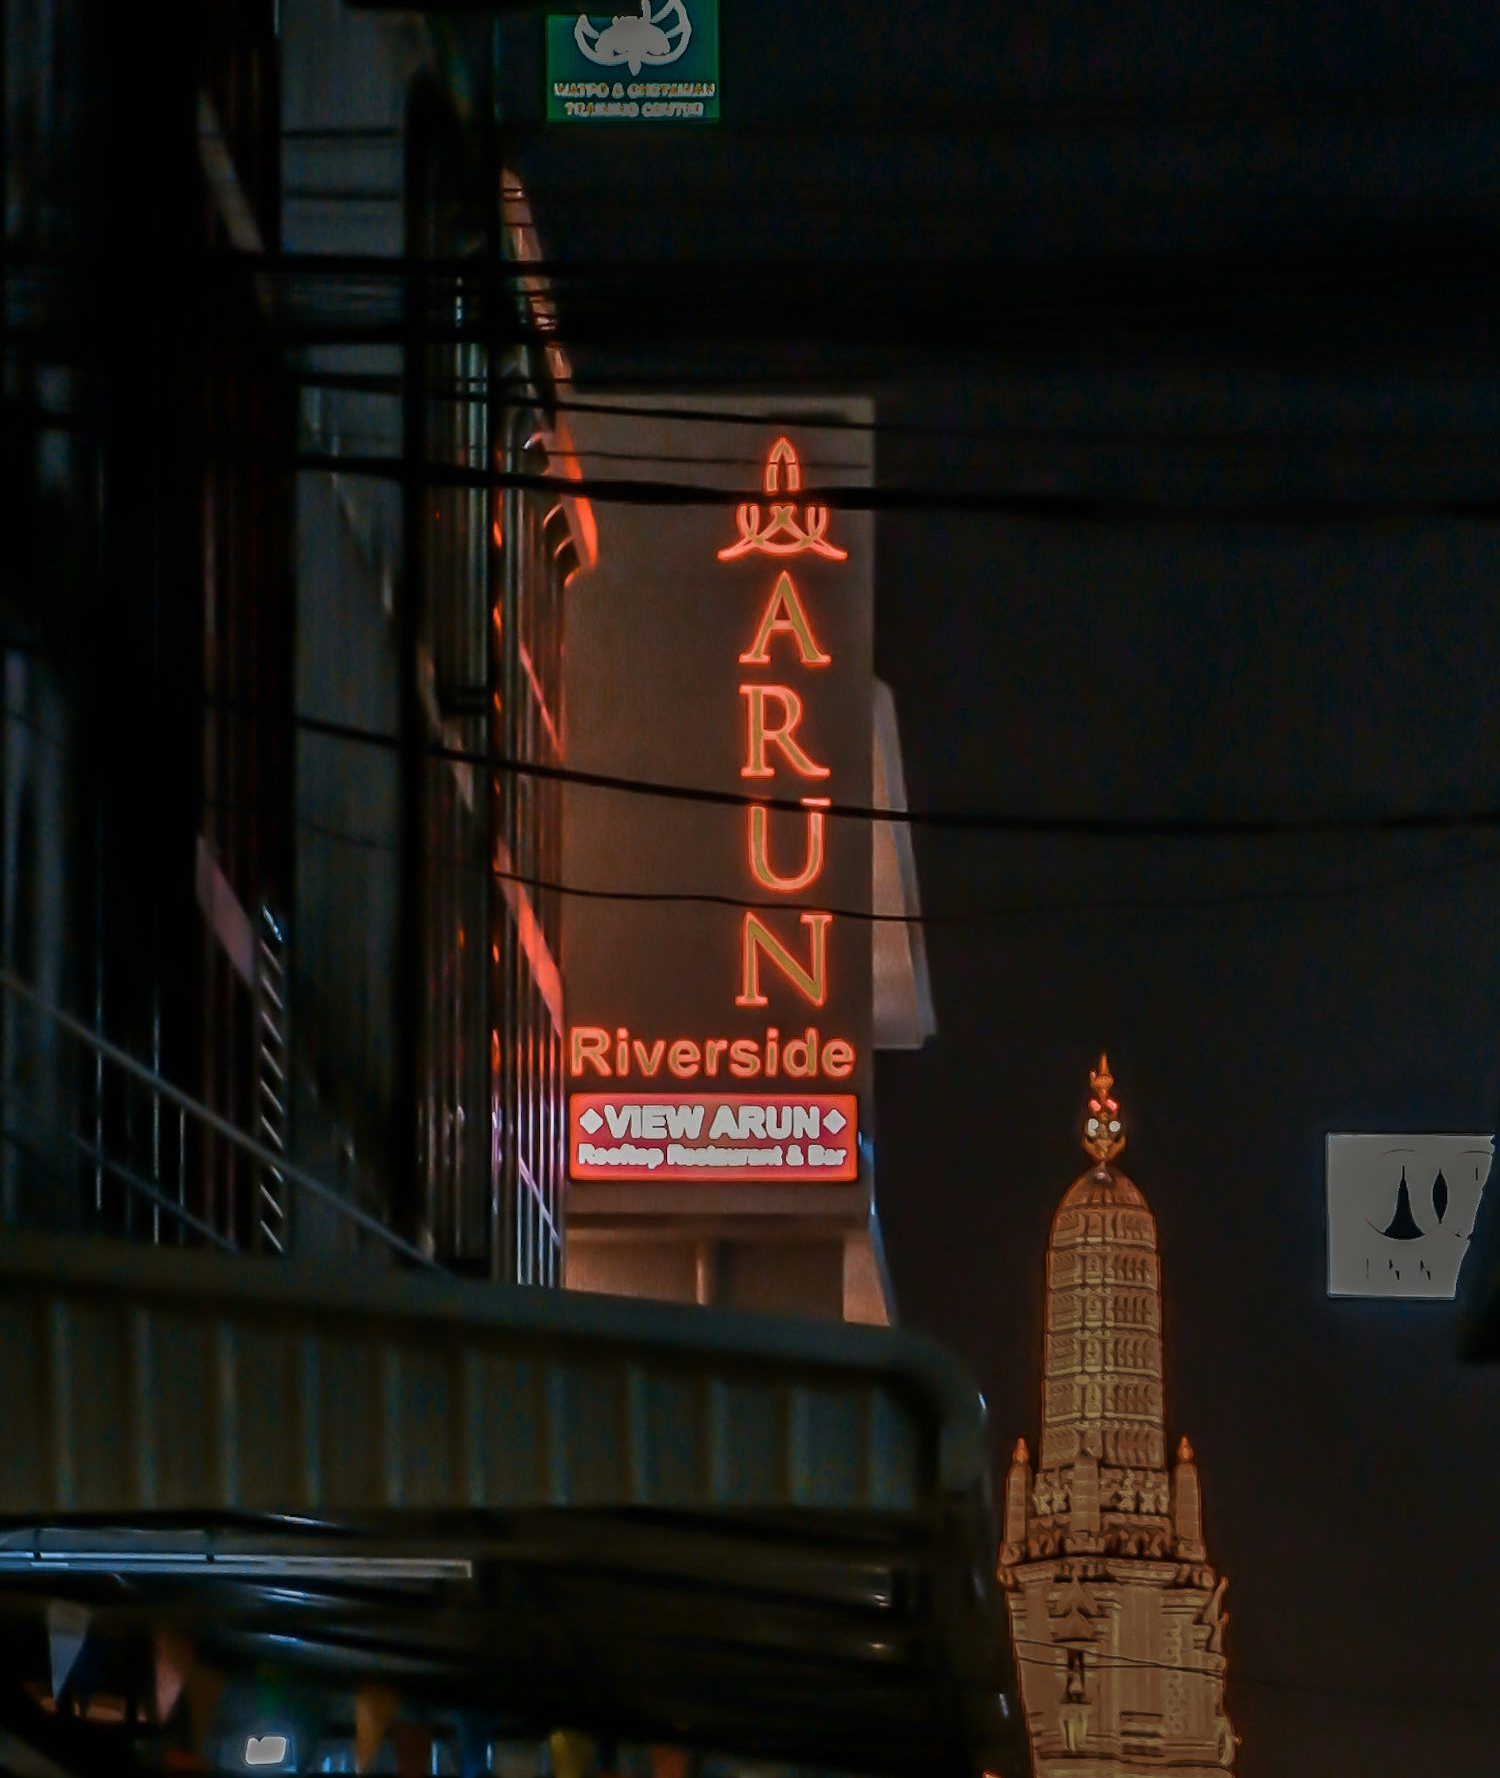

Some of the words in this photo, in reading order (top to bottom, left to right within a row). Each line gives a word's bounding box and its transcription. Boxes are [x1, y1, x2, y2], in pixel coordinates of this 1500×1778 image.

[735, 569, 832, 1009] ARUN
[569, 1026, 856, 1078] Riverside
[604, 1104, 704, 1140] VIEW
[708, 1105, 821, 1140] ARUN
